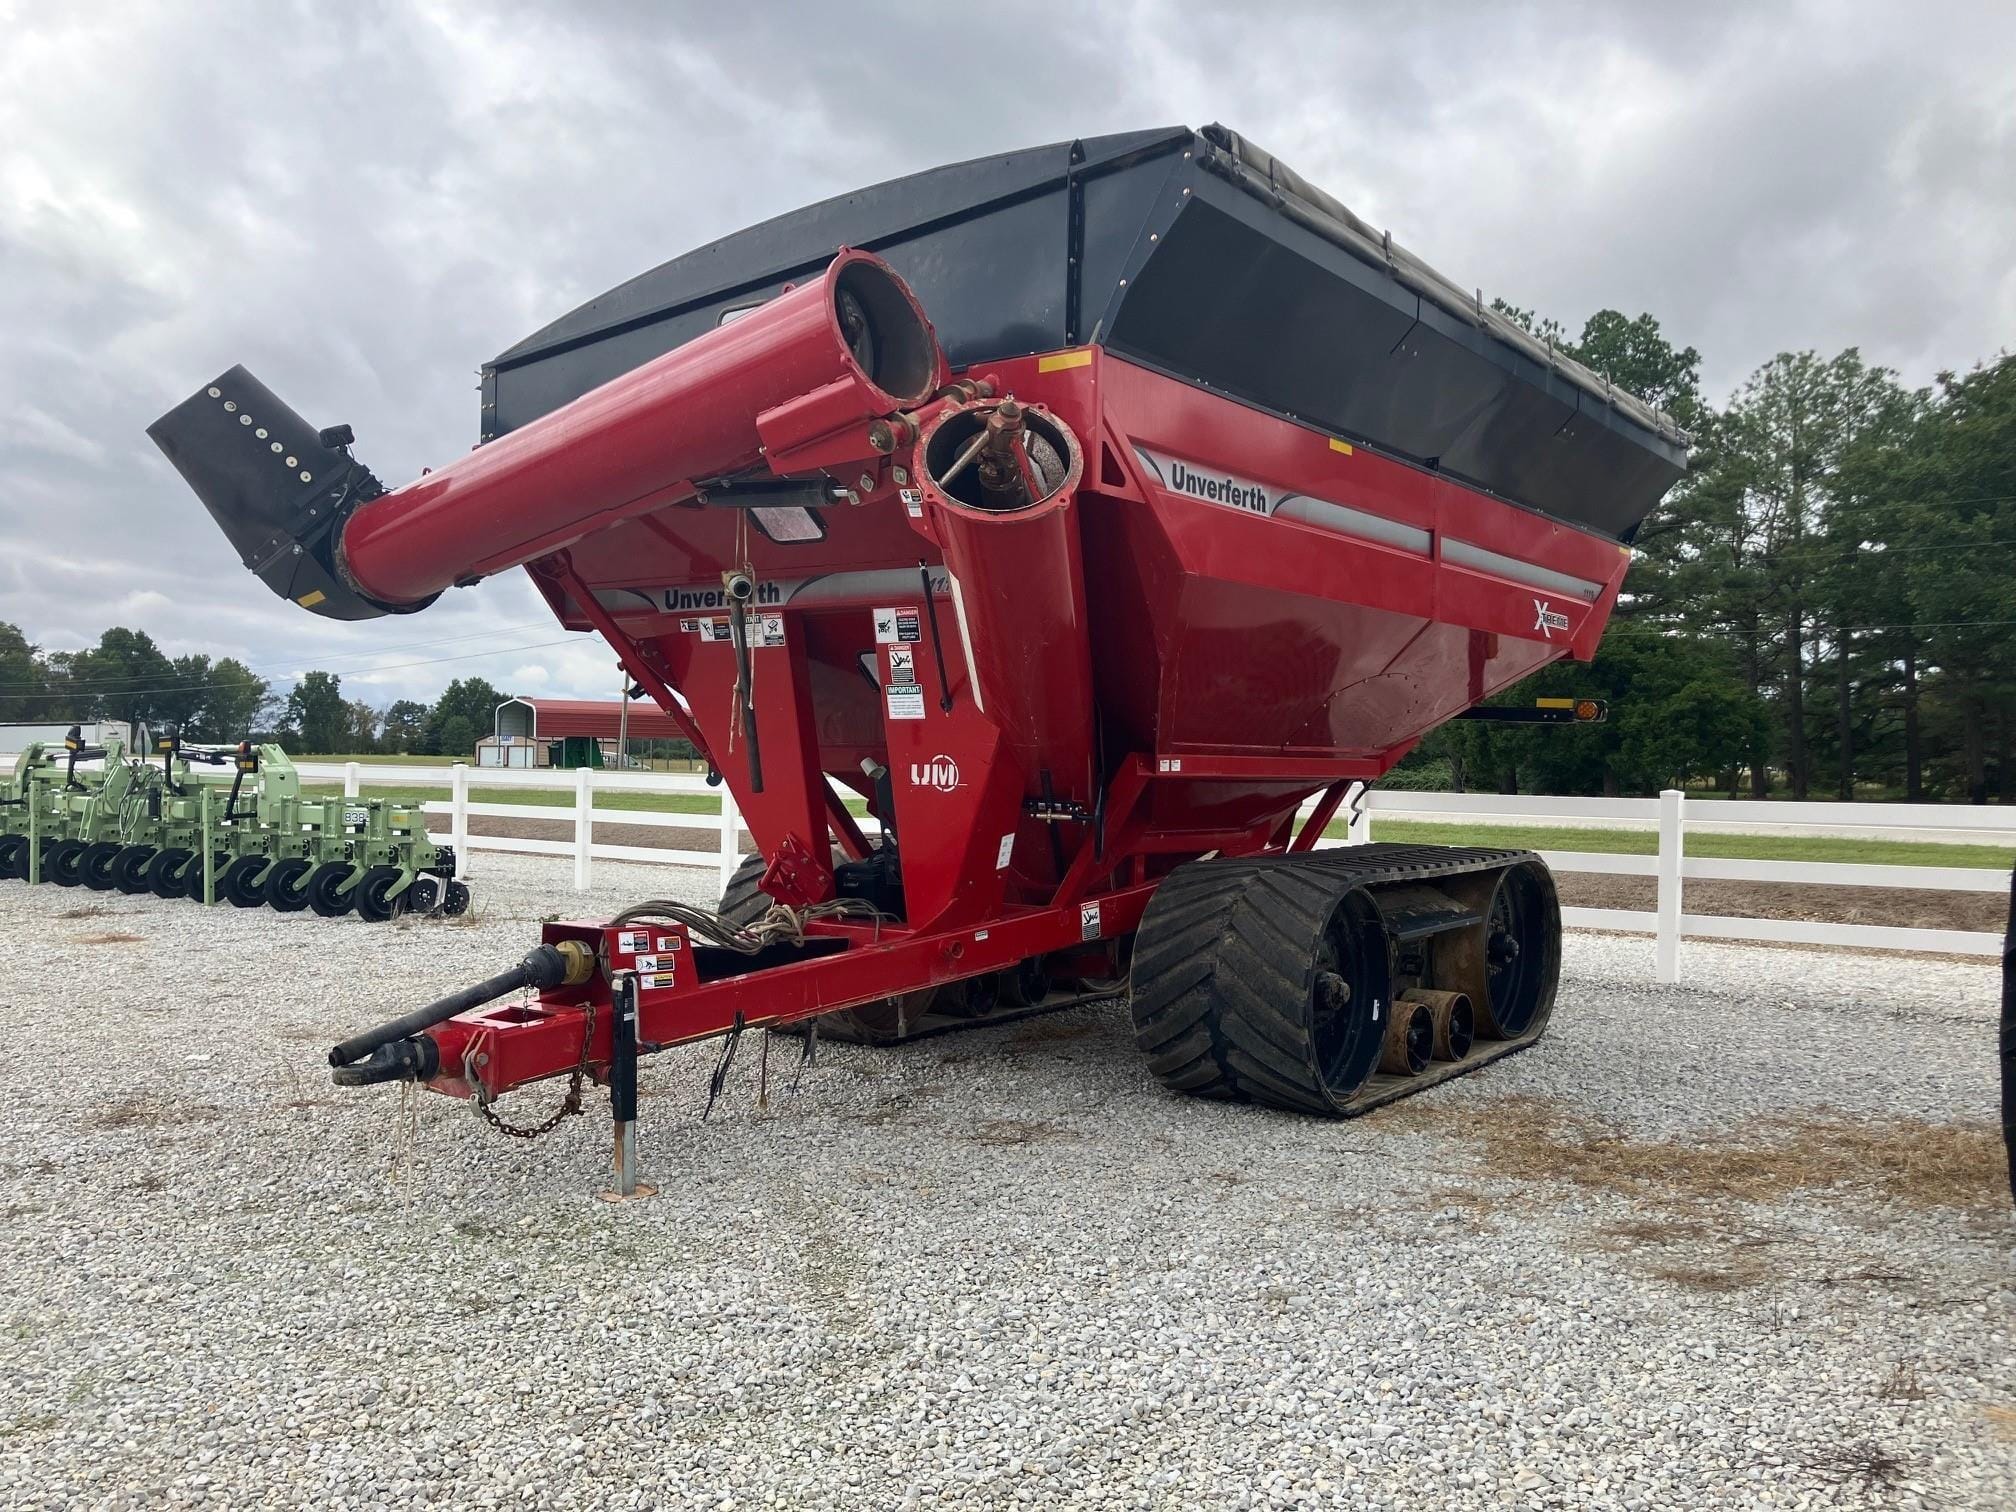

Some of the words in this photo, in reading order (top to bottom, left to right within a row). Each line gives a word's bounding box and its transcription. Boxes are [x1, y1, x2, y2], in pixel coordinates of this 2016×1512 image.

[1172, 463, 1266, 513] Unverferth
[664, 582, 780, 610] Unverth
[888, 686, 920, 695] IMPORTANT
